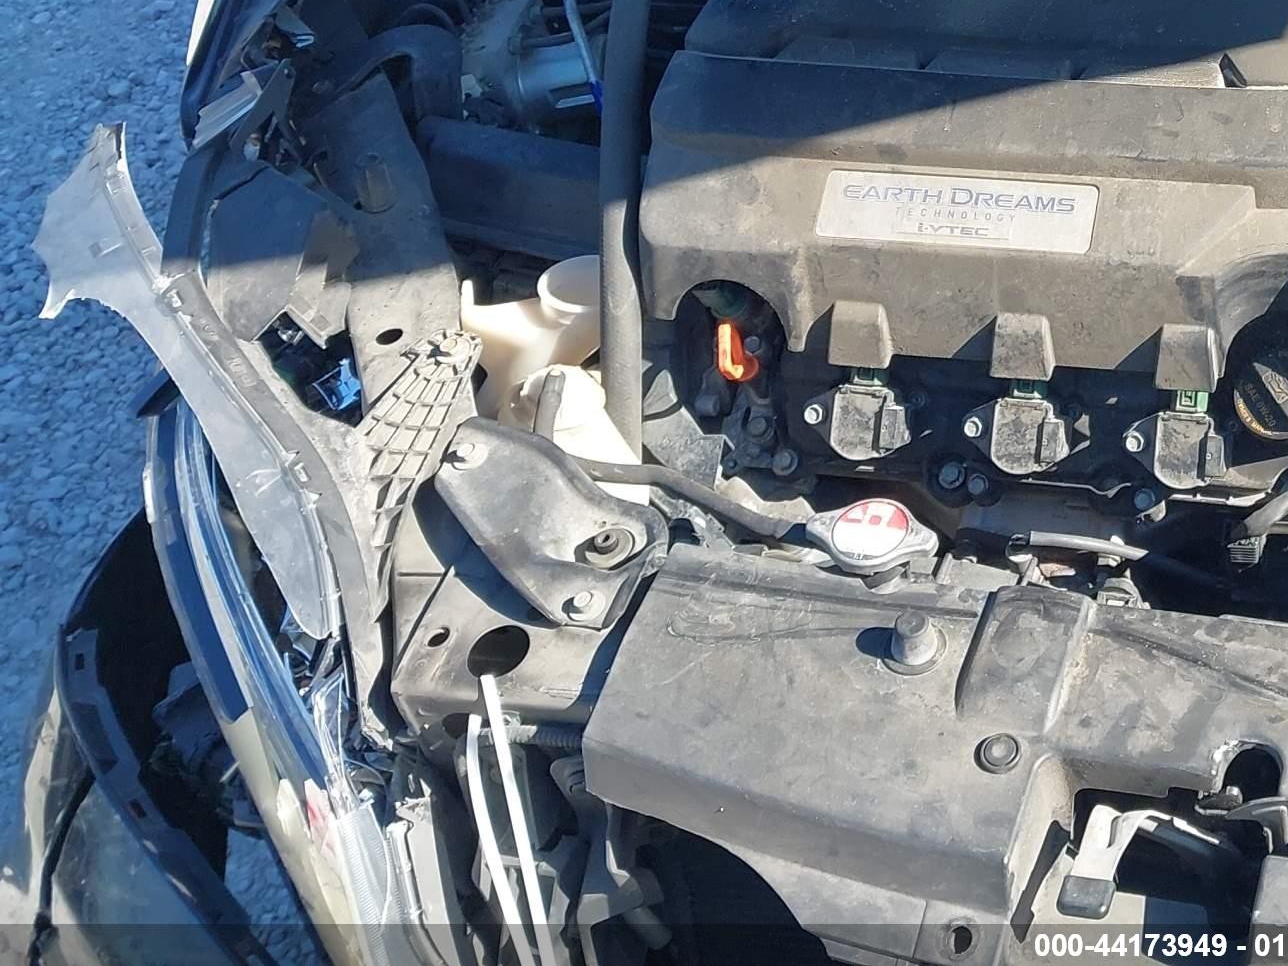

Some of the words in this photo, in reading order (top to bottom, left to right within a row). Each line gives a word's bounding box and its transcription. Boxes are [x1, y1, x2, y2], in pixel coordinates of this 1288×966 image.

[843, 184, 942, 204] EARTH
[950, 186, 1076, 213] DREAMS
[895, 207, 1016, 223] TECHNOLOGY
[917, 222, 989, 237] i-VTEC
